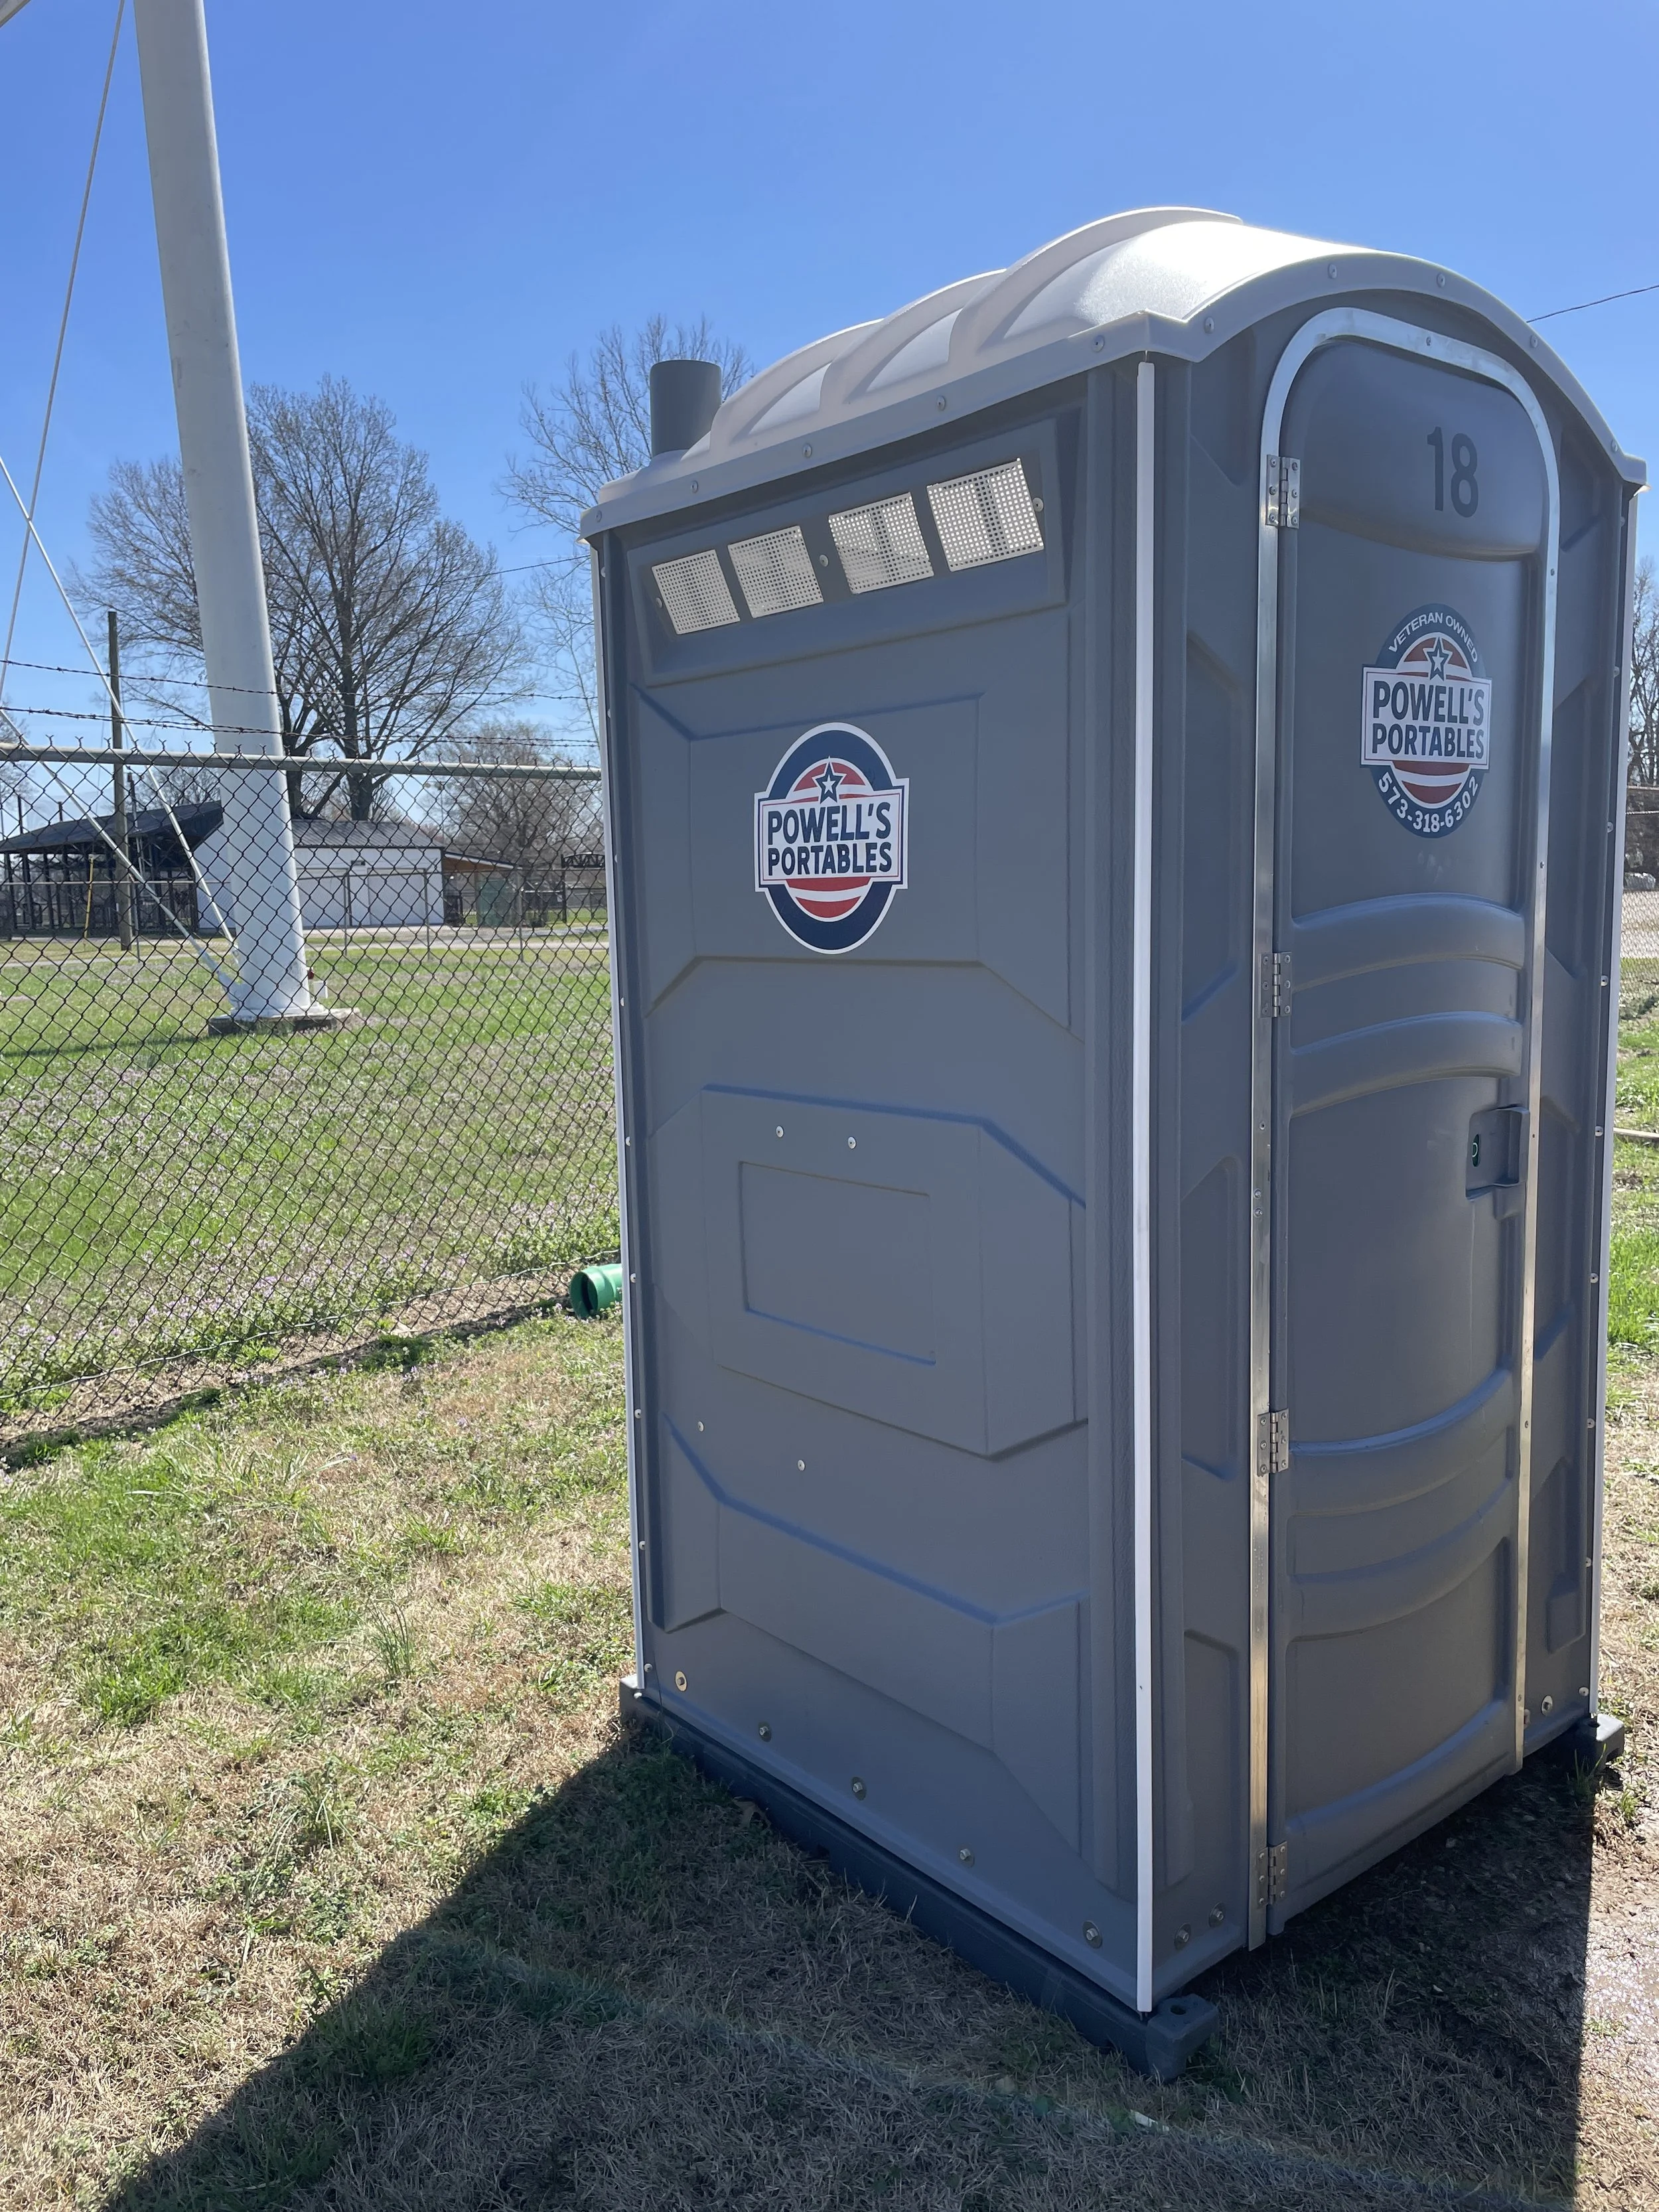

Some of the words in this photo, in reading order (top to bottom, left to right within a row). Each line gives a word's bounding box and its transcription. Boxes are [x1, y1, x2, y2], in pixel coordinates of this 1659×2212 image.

[1427, 426, 1479, 518] 18
[1388, 612, 1443, 652] VETERAN
[1445, 615, 1478, 663] OWNED
[1372, 680, 1485, 726] POWELL'S
[1372, 723, 1484, 759] PORTABLES
[768, 802, 891, 846] POWELL'S
[1378, 772, 1479, 832] 573-318-6302
[768, 842, 892, 876] PORTABLES
